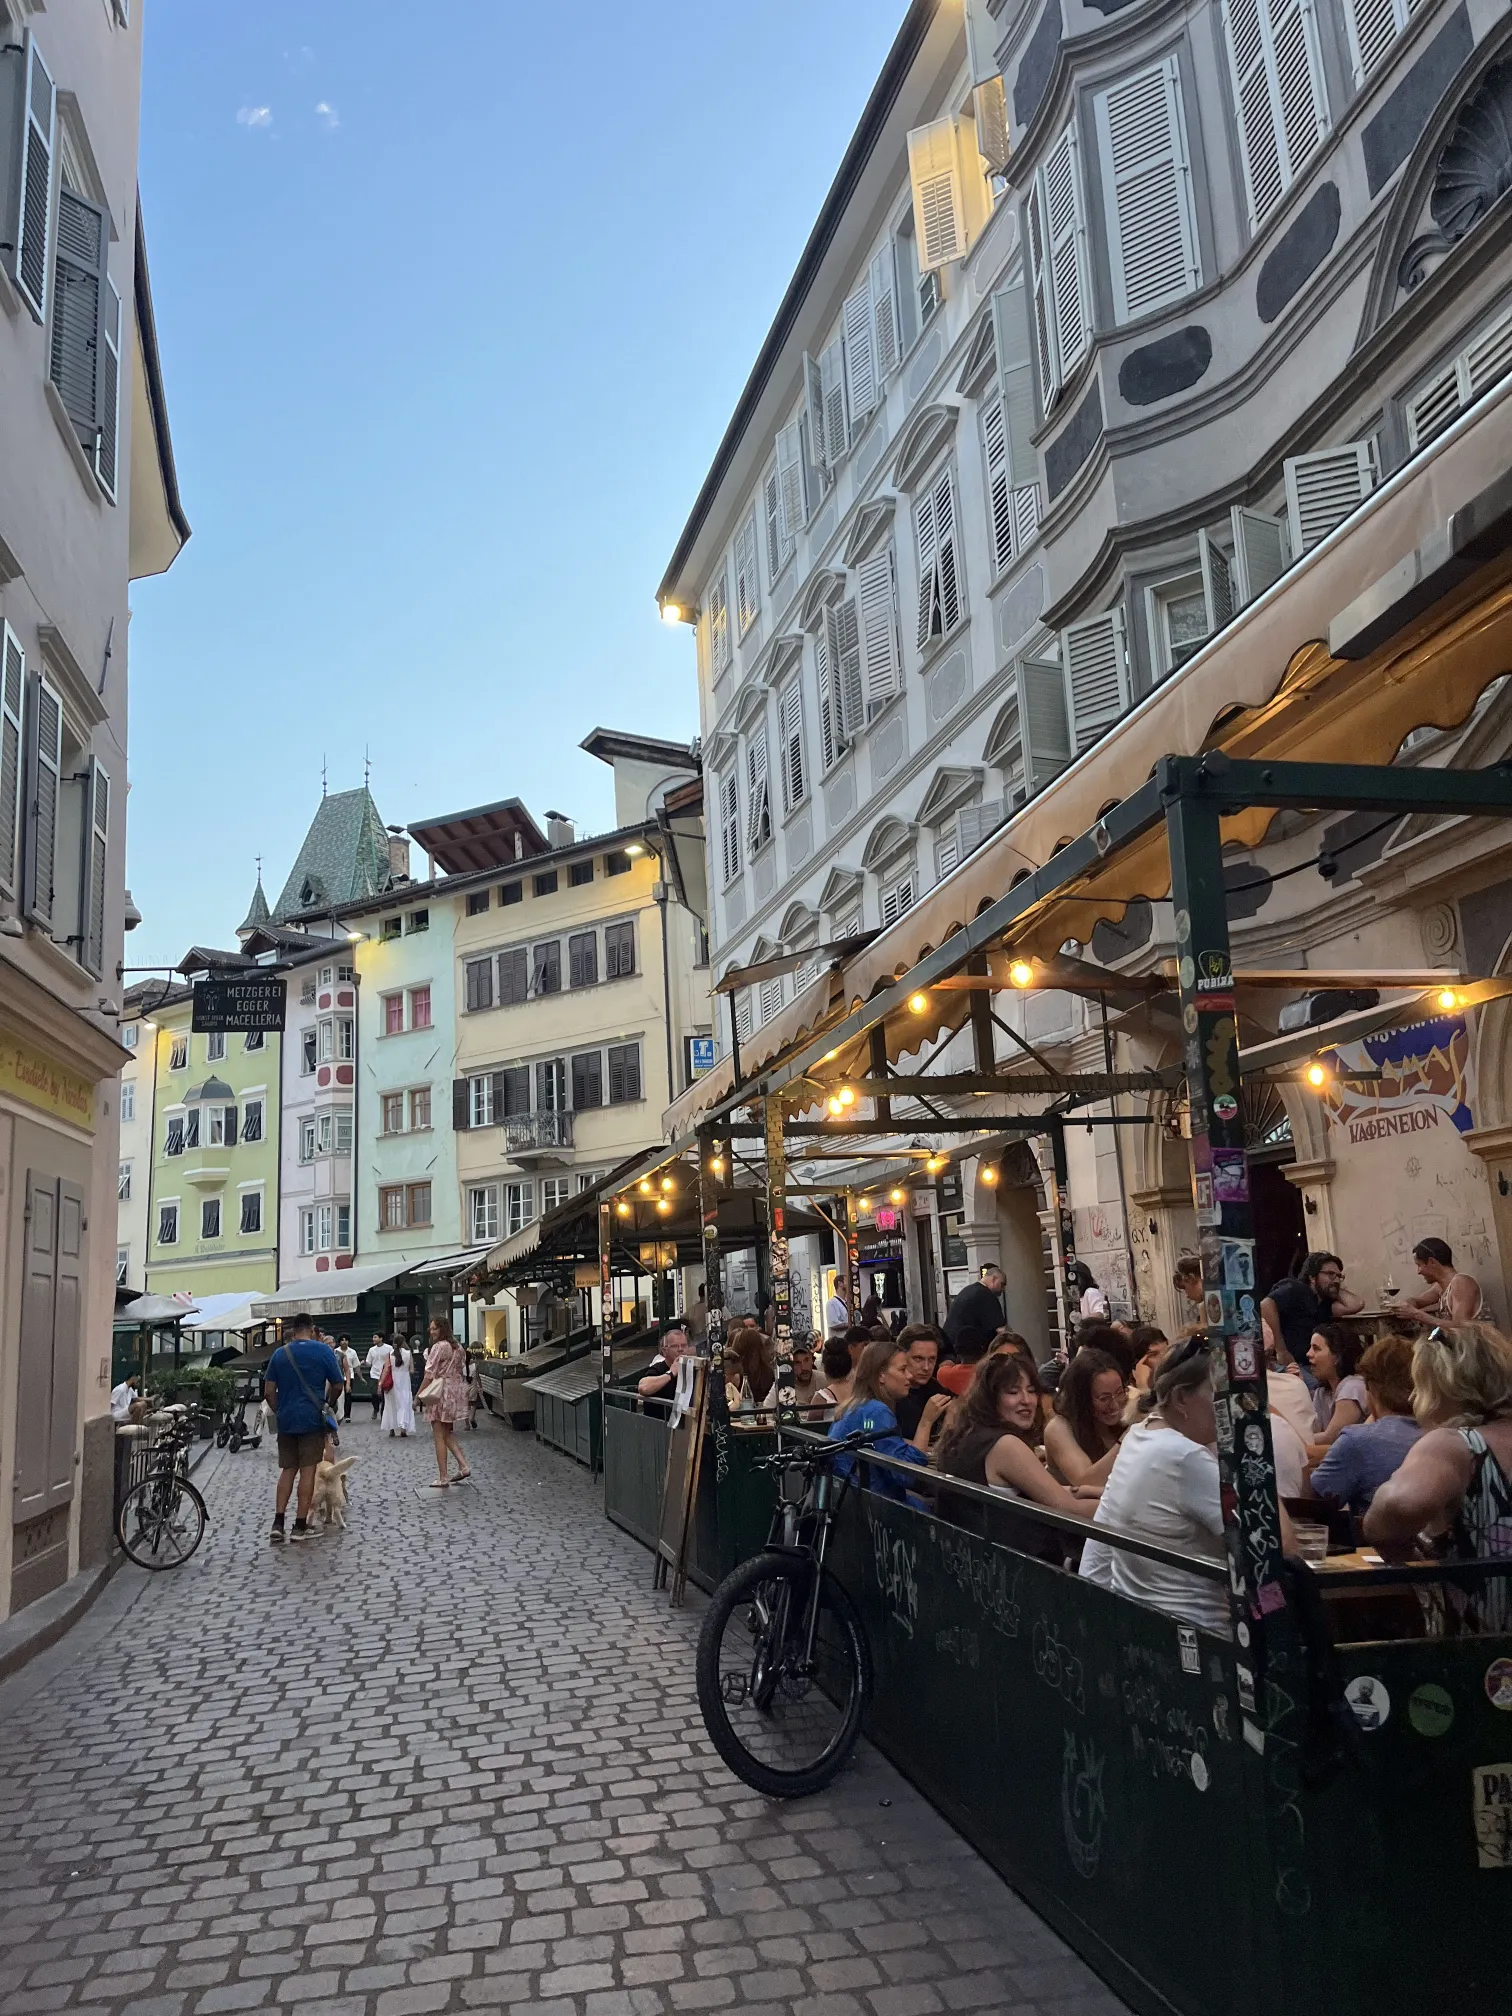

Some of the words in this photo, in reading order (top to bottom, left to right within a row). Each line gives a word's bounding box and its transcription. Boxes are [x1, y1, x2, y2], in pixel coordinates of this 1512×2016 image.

[1197, 975, 1234, 990] PUBIRA
[227, 986, 281, 998] METZGEREI
[236, 1000, 269, 1012] EGGER
[225, 1013, 282, 1026] MACELLERIA
